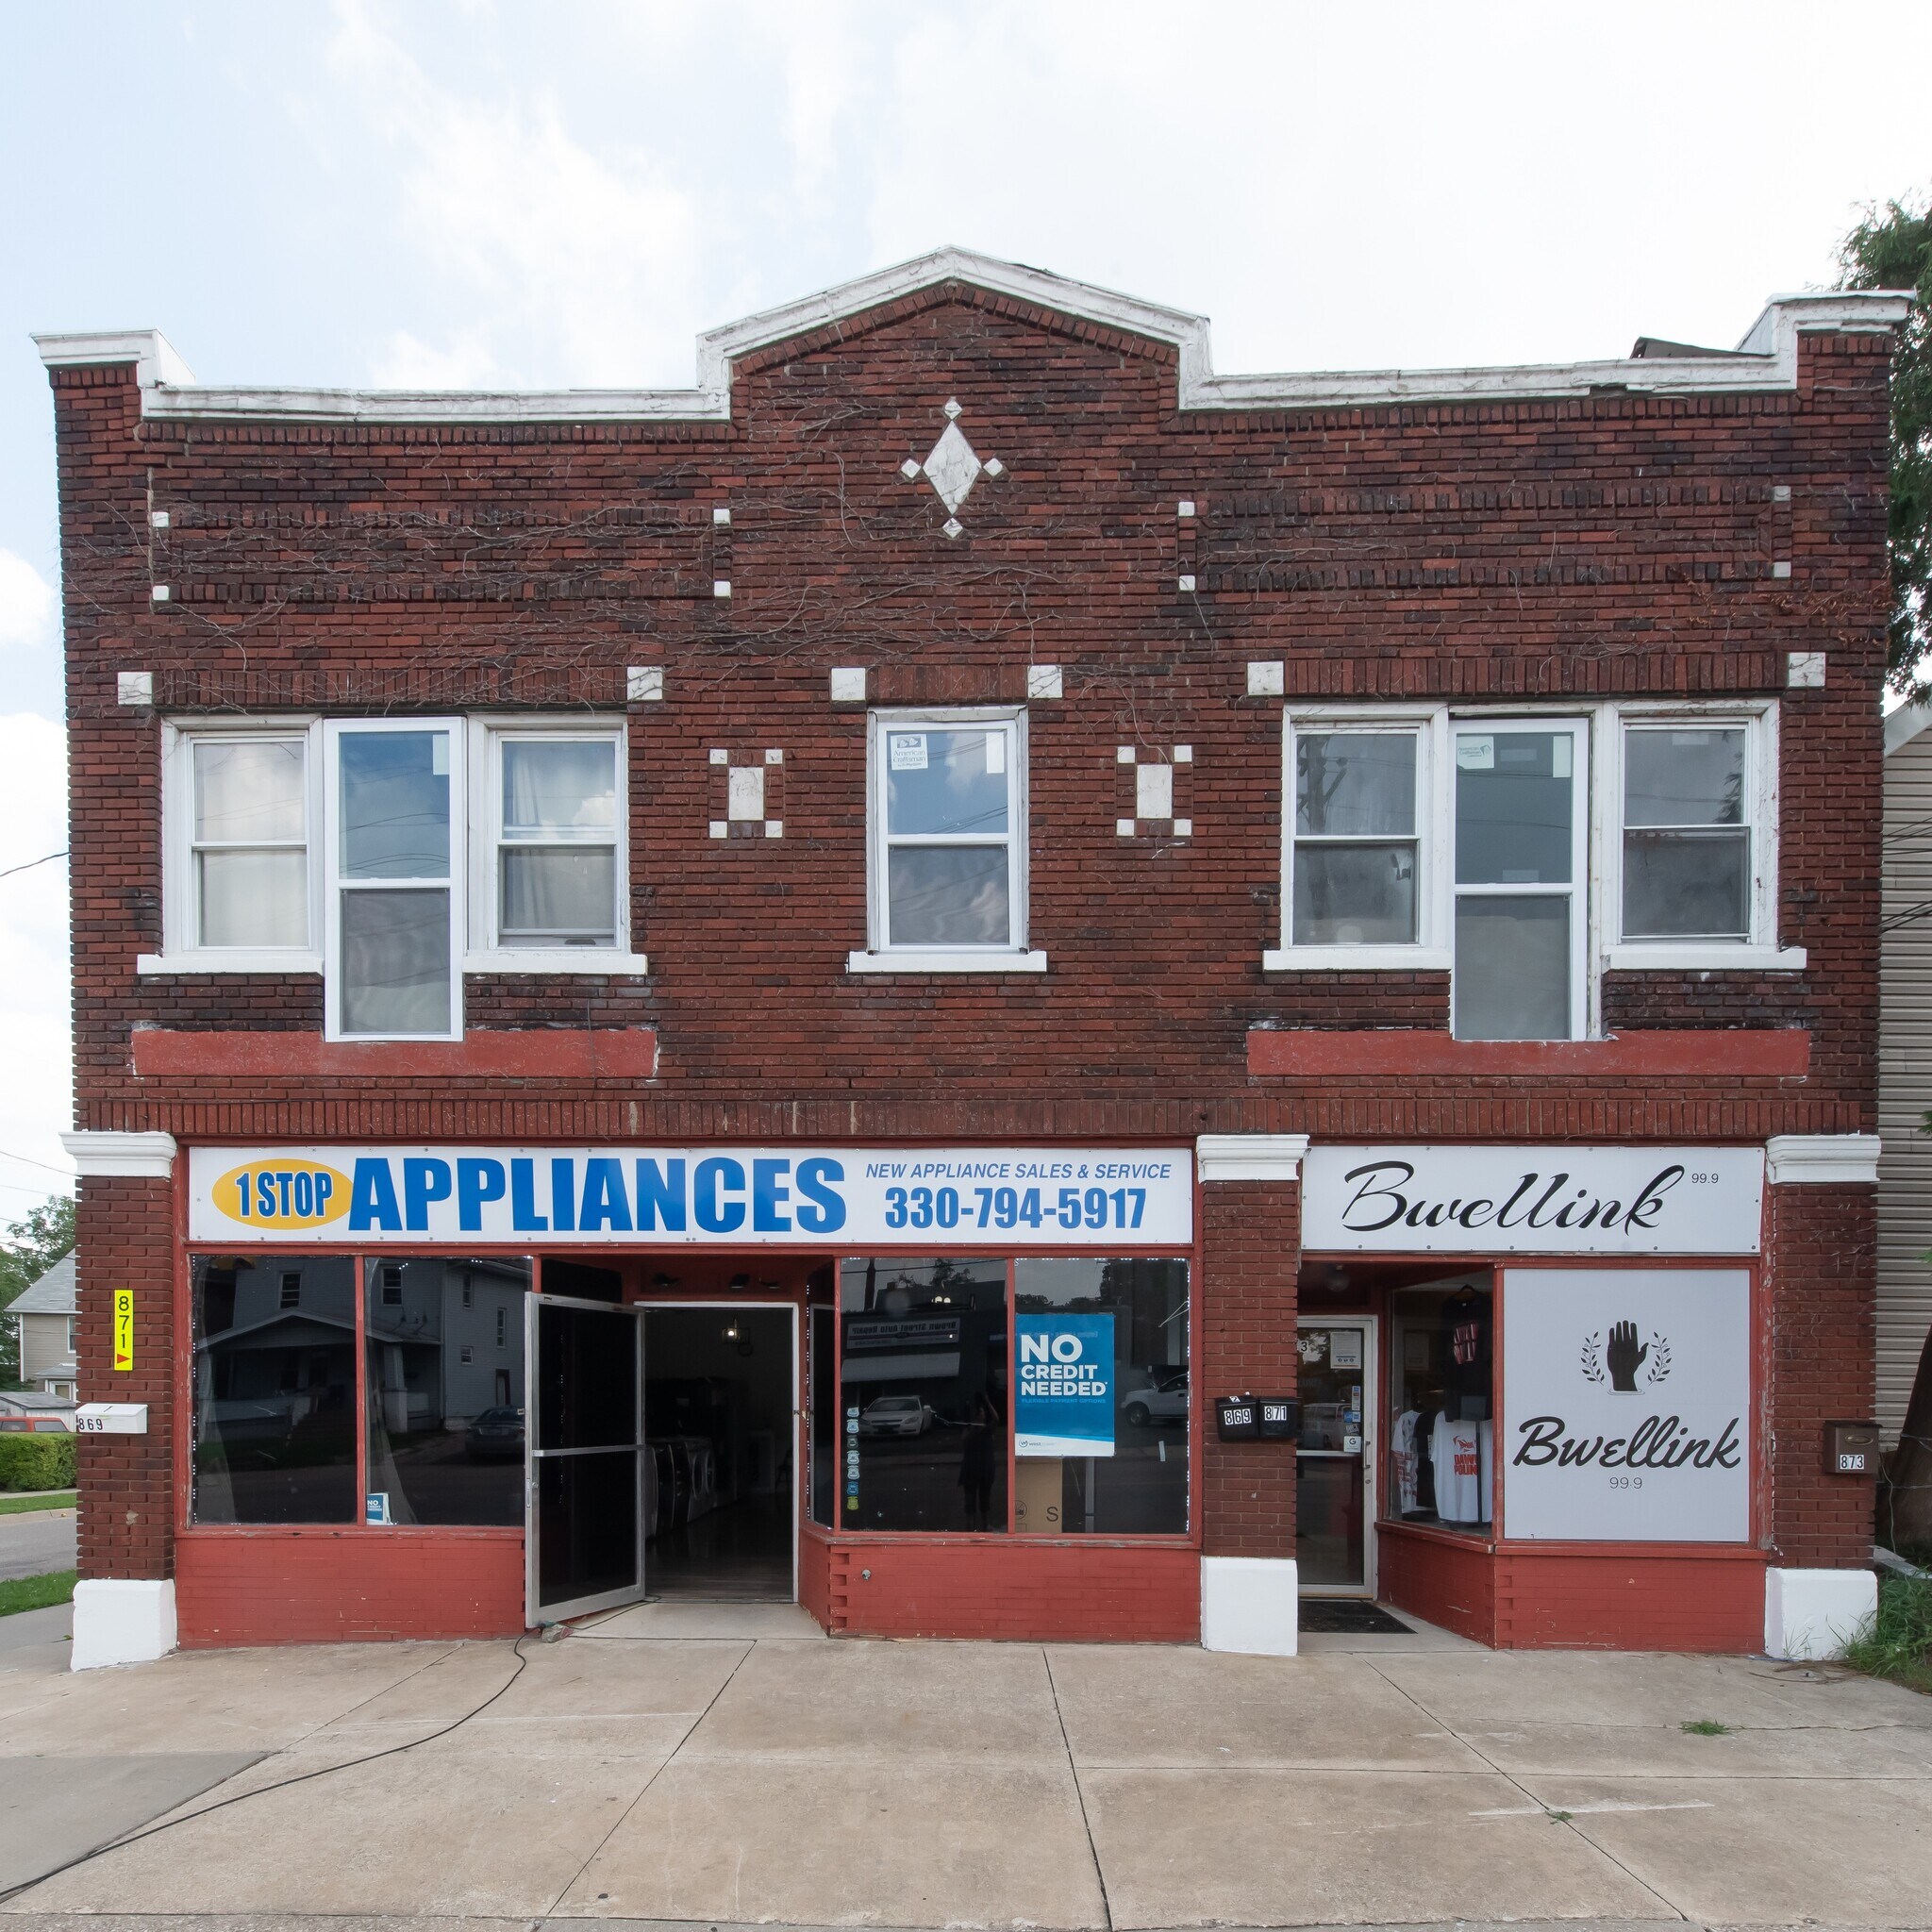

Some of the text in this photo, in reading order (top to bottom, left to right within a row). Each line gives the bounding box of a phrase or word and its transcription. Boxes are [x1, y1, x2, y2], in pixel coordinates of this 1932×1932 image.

[866, 1163, 1172, 1179] NEW APPLIANCE SALES & SERVICE
[1691, 1172, 1719, 1184] 99.9
[235, 1171, 334, 1219] 1 STOP
[348, 1157, 847, 1234] APPLIANCES
[1342, 1160, 1685, 1236] Bwellink
[885, 1187, 1146, 1229] 330-794-5917
[119, 1295, 129, 1349] 871
[1021, 1334, 1083, 1363] NO
[1021, 1364, 1098, 1380] CREDIT
[78, 1418, 103, 1430] 869
[1225, 1407, 1287, 1424] 869 871
[1512, 1415, 1741, 1469] Bwellink
[1841, 1456, 1863, 1468] 873
[1609, 1476, 1643, 1490] 99.9
